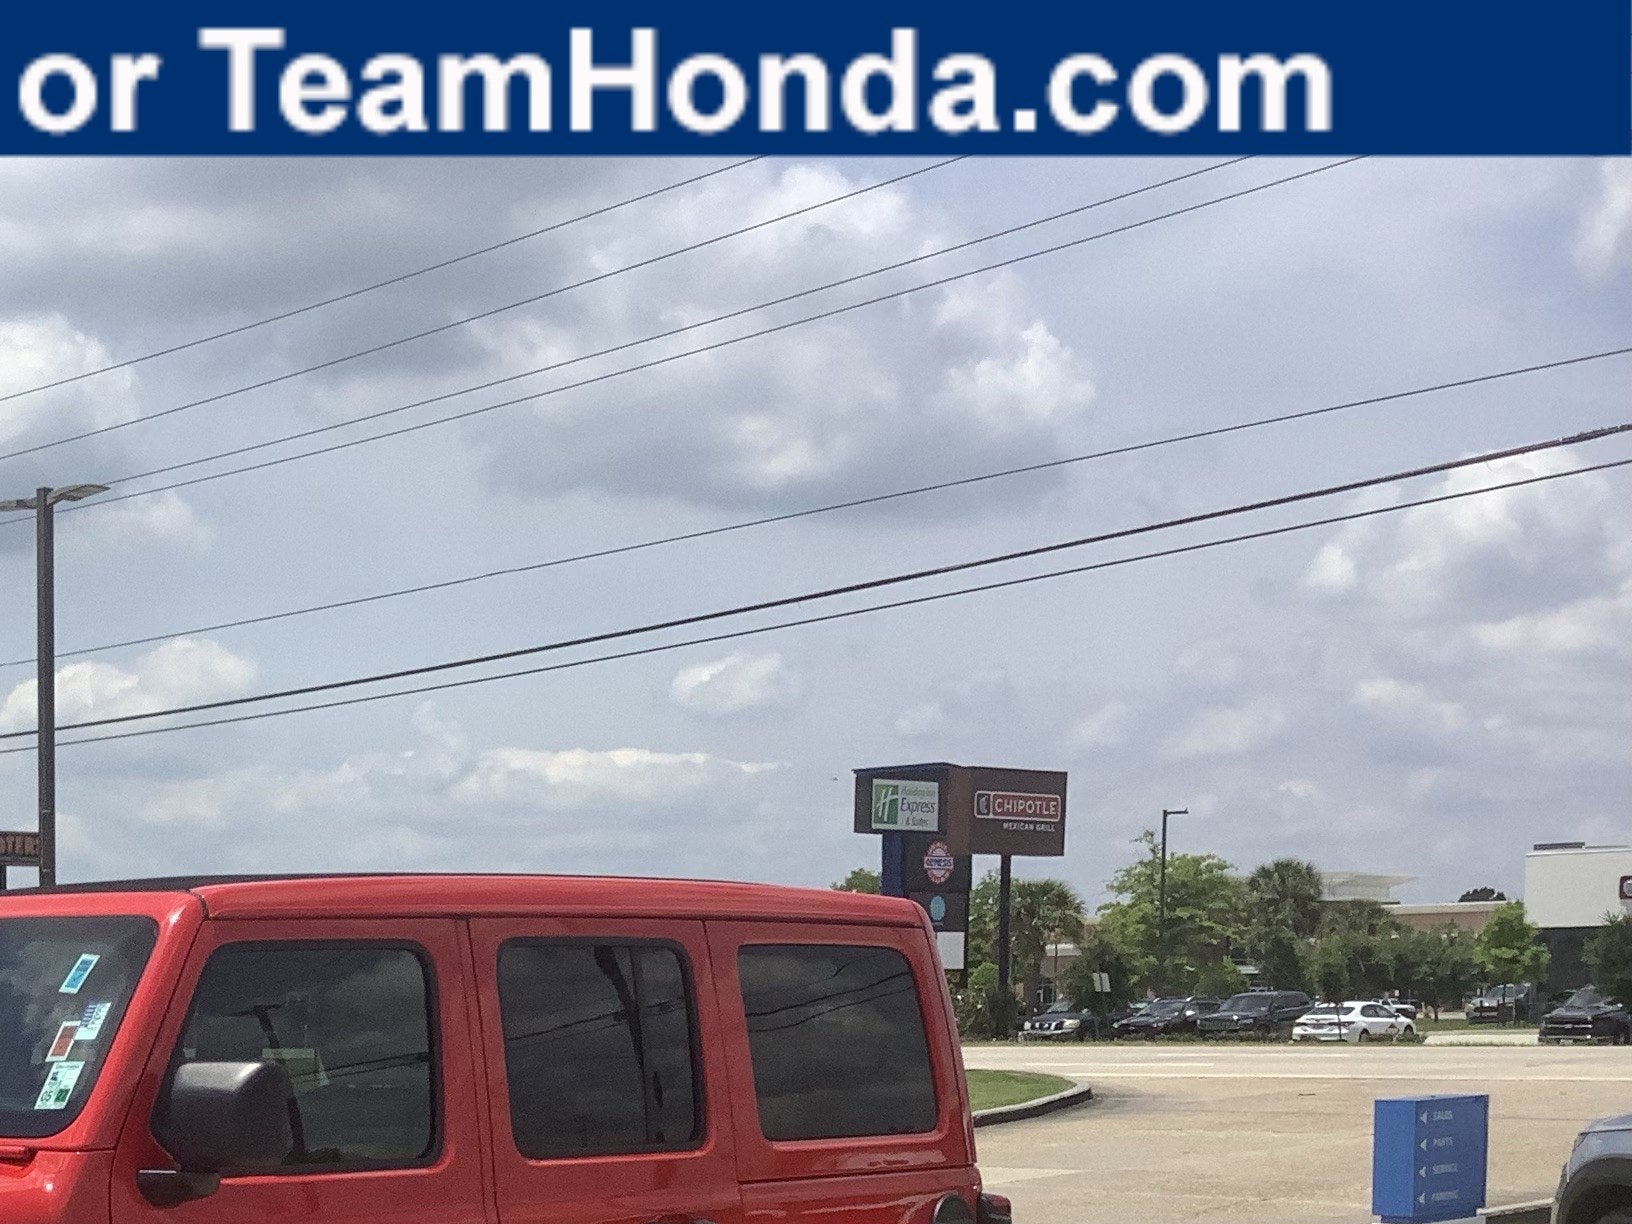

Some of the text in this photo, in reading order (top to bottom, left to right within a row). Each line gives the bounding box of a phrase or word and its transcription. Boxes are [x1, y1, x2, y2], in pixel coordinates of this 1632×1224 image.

[900, 797, 936, 815] Express
[994, 798, 1058, 815] CHIPOTLE
[1003, 822, 1056, 832] MEXICAN GRILL
